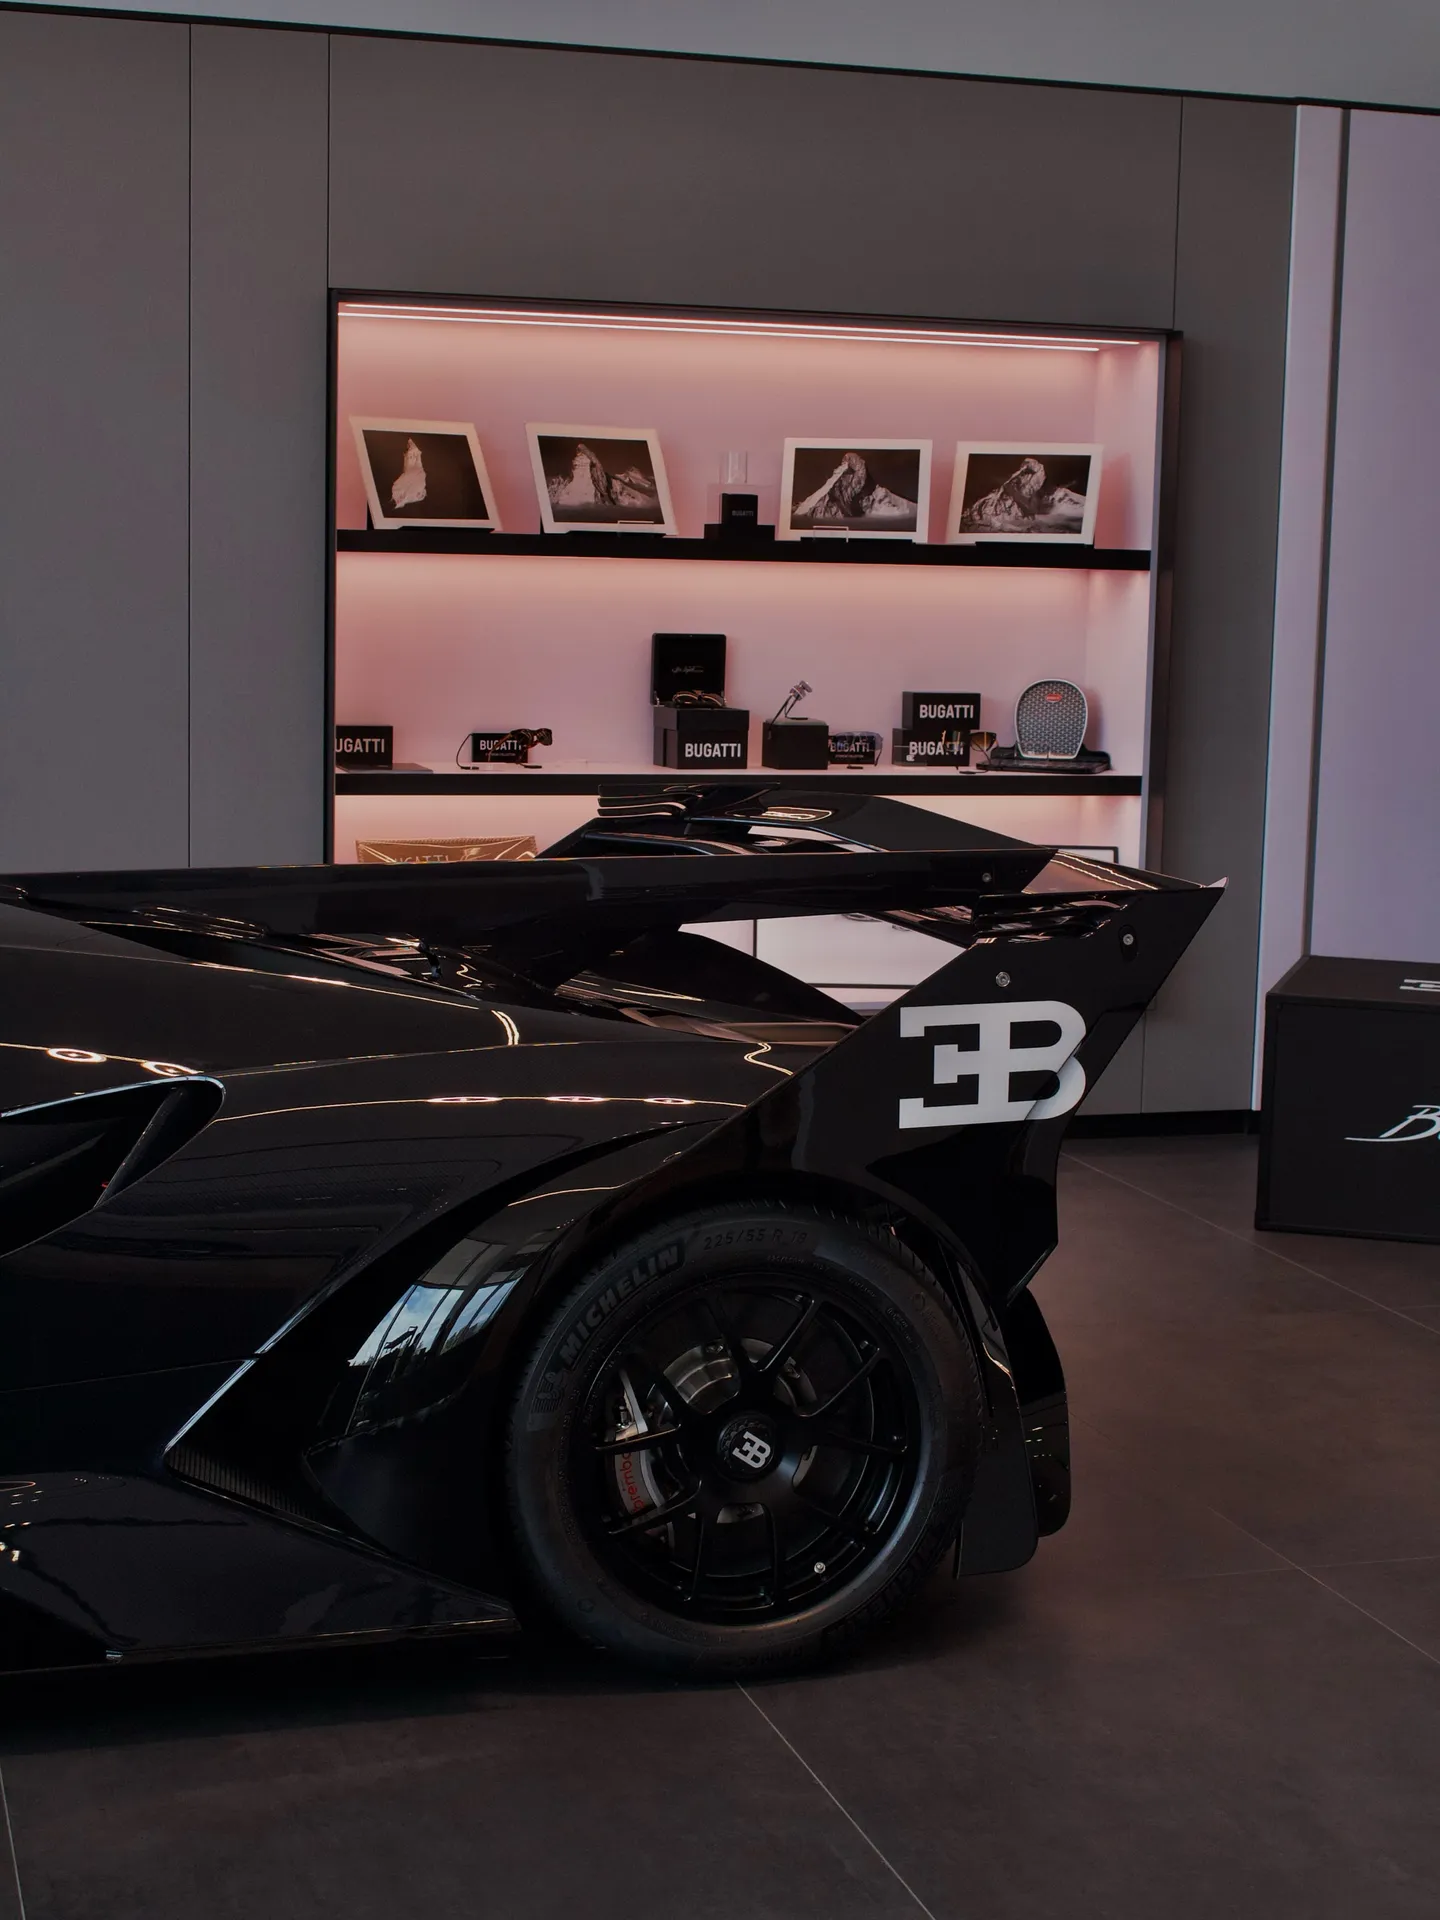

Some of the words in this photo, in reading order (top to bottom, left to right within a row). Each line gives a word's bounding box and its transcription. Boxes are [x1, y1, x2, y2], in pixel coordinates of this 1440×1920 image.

[919, 704, 974, 719] BUGATTI
[684, 742, 742, 758] BUGATTI
[830, 741, 870, 753] BUGATTI
[703, 1227, 767, 1251] 225/55
[558, 1243, 681, 1367] MICHELIN
